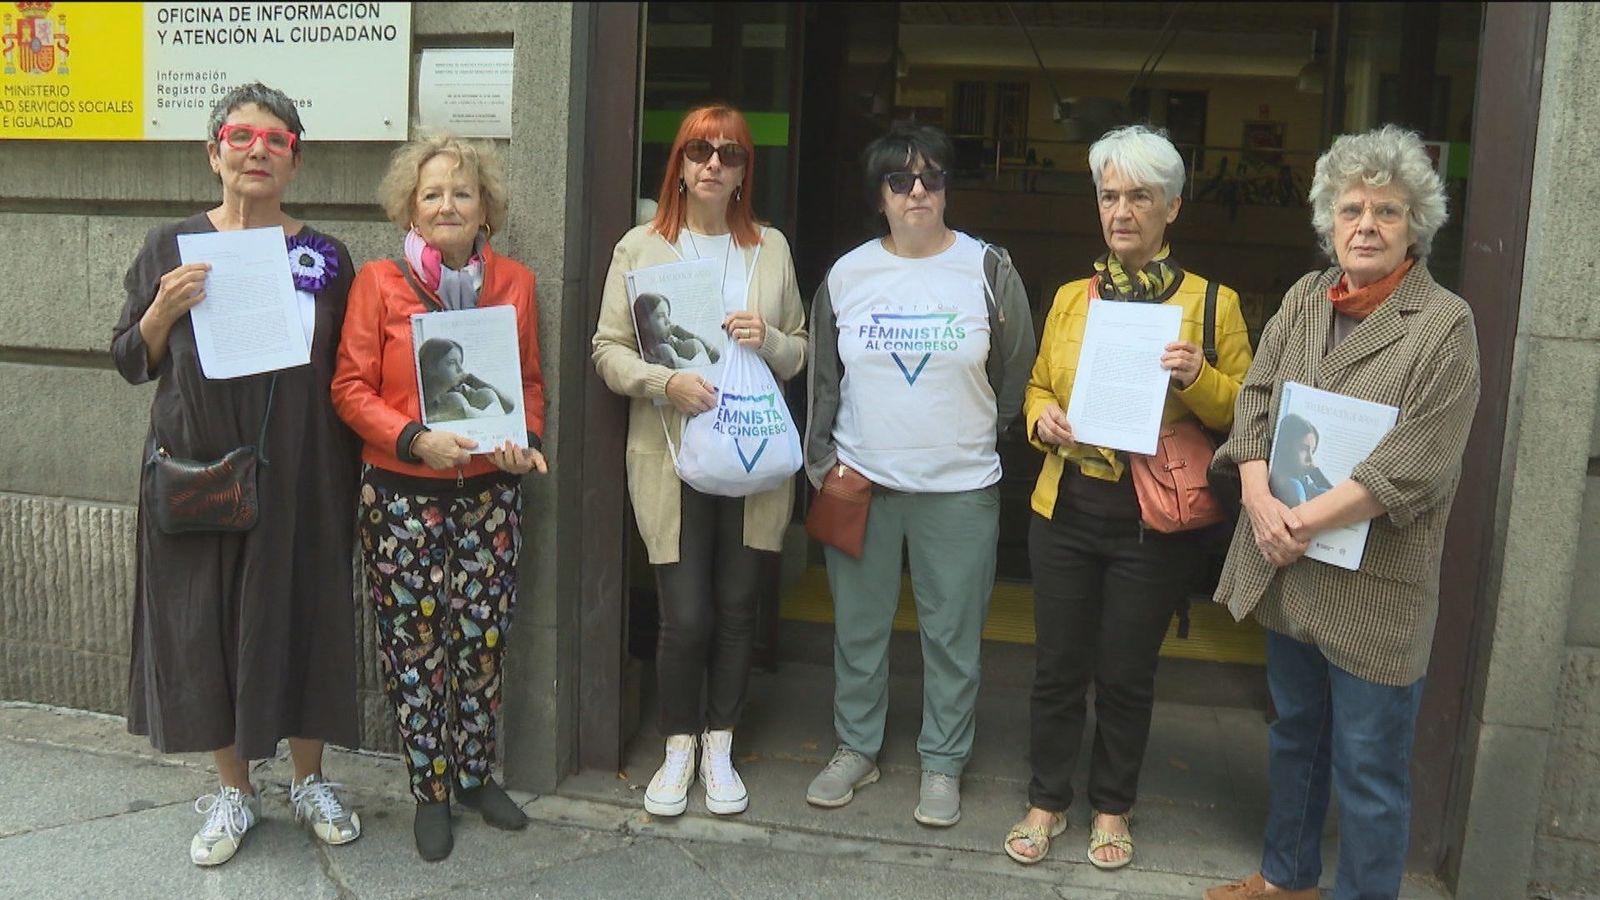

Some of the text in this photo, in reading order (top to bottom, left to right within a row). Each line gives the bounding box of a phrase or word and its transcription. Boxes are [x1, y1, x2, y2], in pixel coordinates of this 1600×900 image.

[157, 8, 224, 24] OFICINA
[229, 6, 251, 22] DE
[157, 25, 397, 45] Y ATENCIÓN AL CIUDADANO
[157, 70, 227, 81] Información
[4, 85, 70, 97] MINISTERIO
[157, 84, 206, 97] Registro
[19, 100, 76, 113] SERVICIOS
[79, 100, 134, 113] SOCIALES
[157, 98, 205, 108] Servicio
[3, 116, 73, 128] E IGUALDAD
[859, 324, 967, 340] FEMINISTAS
[865, 340, 958, 351] AL CONGRESO
[713, 421, 725, 434] AL
